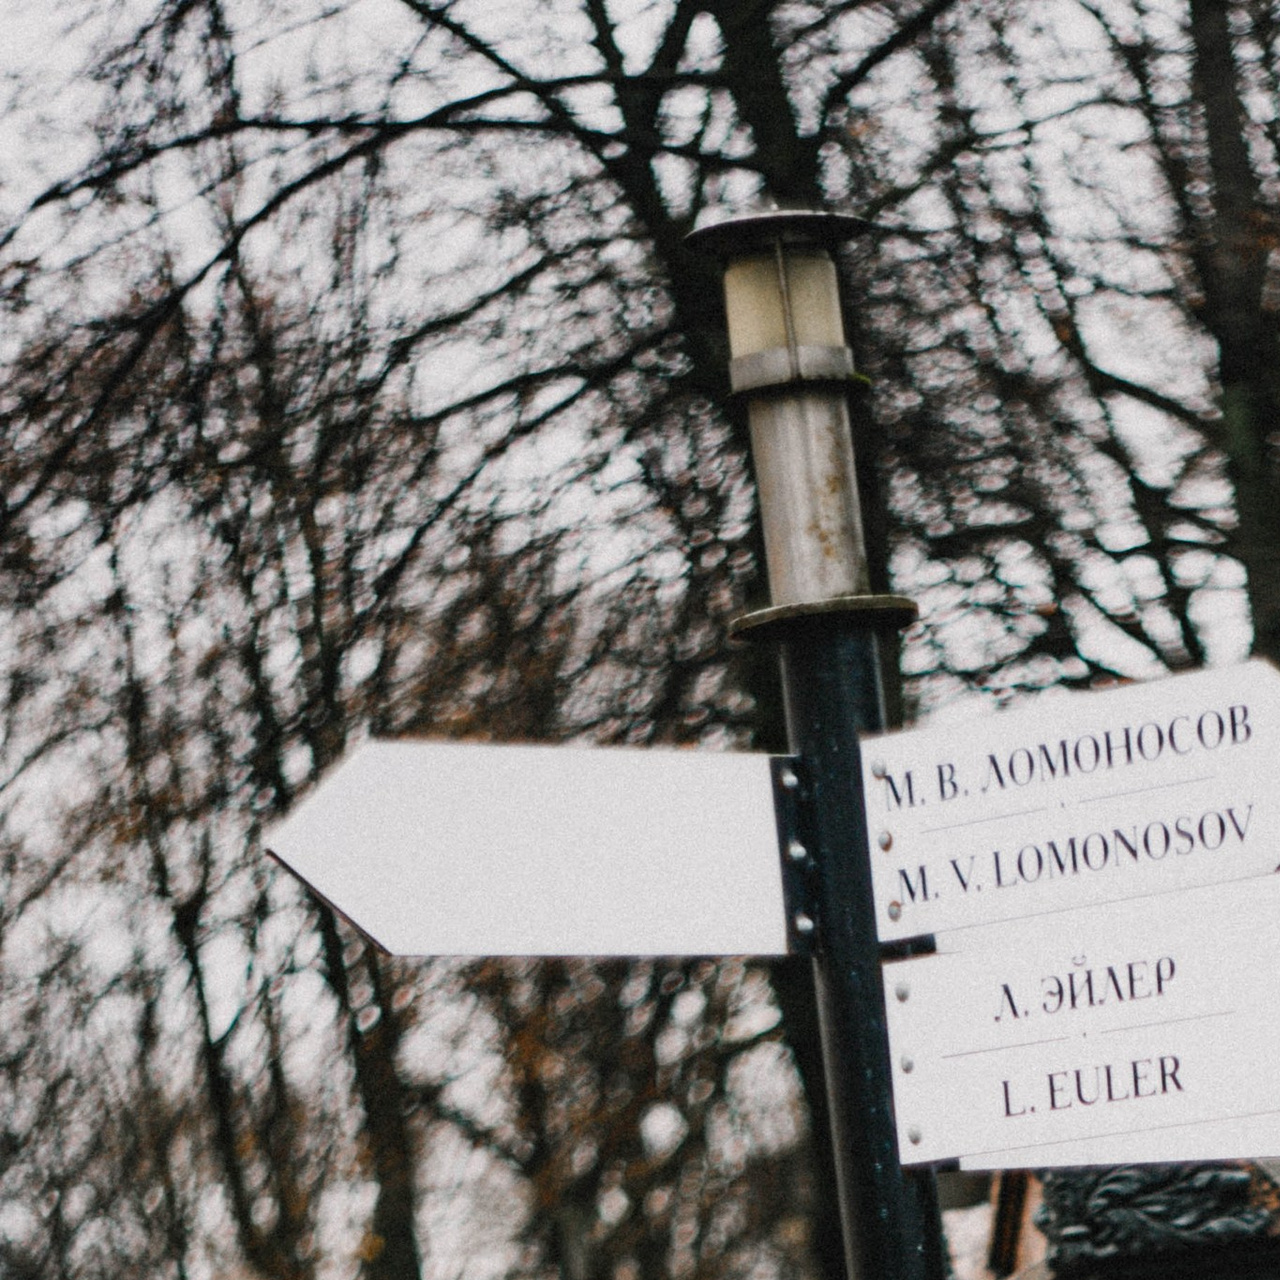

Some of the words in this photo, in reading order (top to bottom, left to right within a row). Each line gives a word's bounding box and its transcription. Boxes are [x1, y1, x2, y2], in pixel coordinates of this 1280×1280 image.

[883, 771, 926, 812] М.
[936, 763, 969, 801] В.
[981, 705, 1253, 793] ЛОМОНОСОВ
[898, 864, 939, 905] M.
[951, 856, 982, 893] V.
[992, 805, 1255, 889] LOMONOSOV
[993, 983, 1030, 1021] Л.
[1041, 955, 1176, 1013] ЭЙЛЕР
[1003, 1080, 1036, 1118] L.
[1047, 1055, 1184, 1110] EULER
